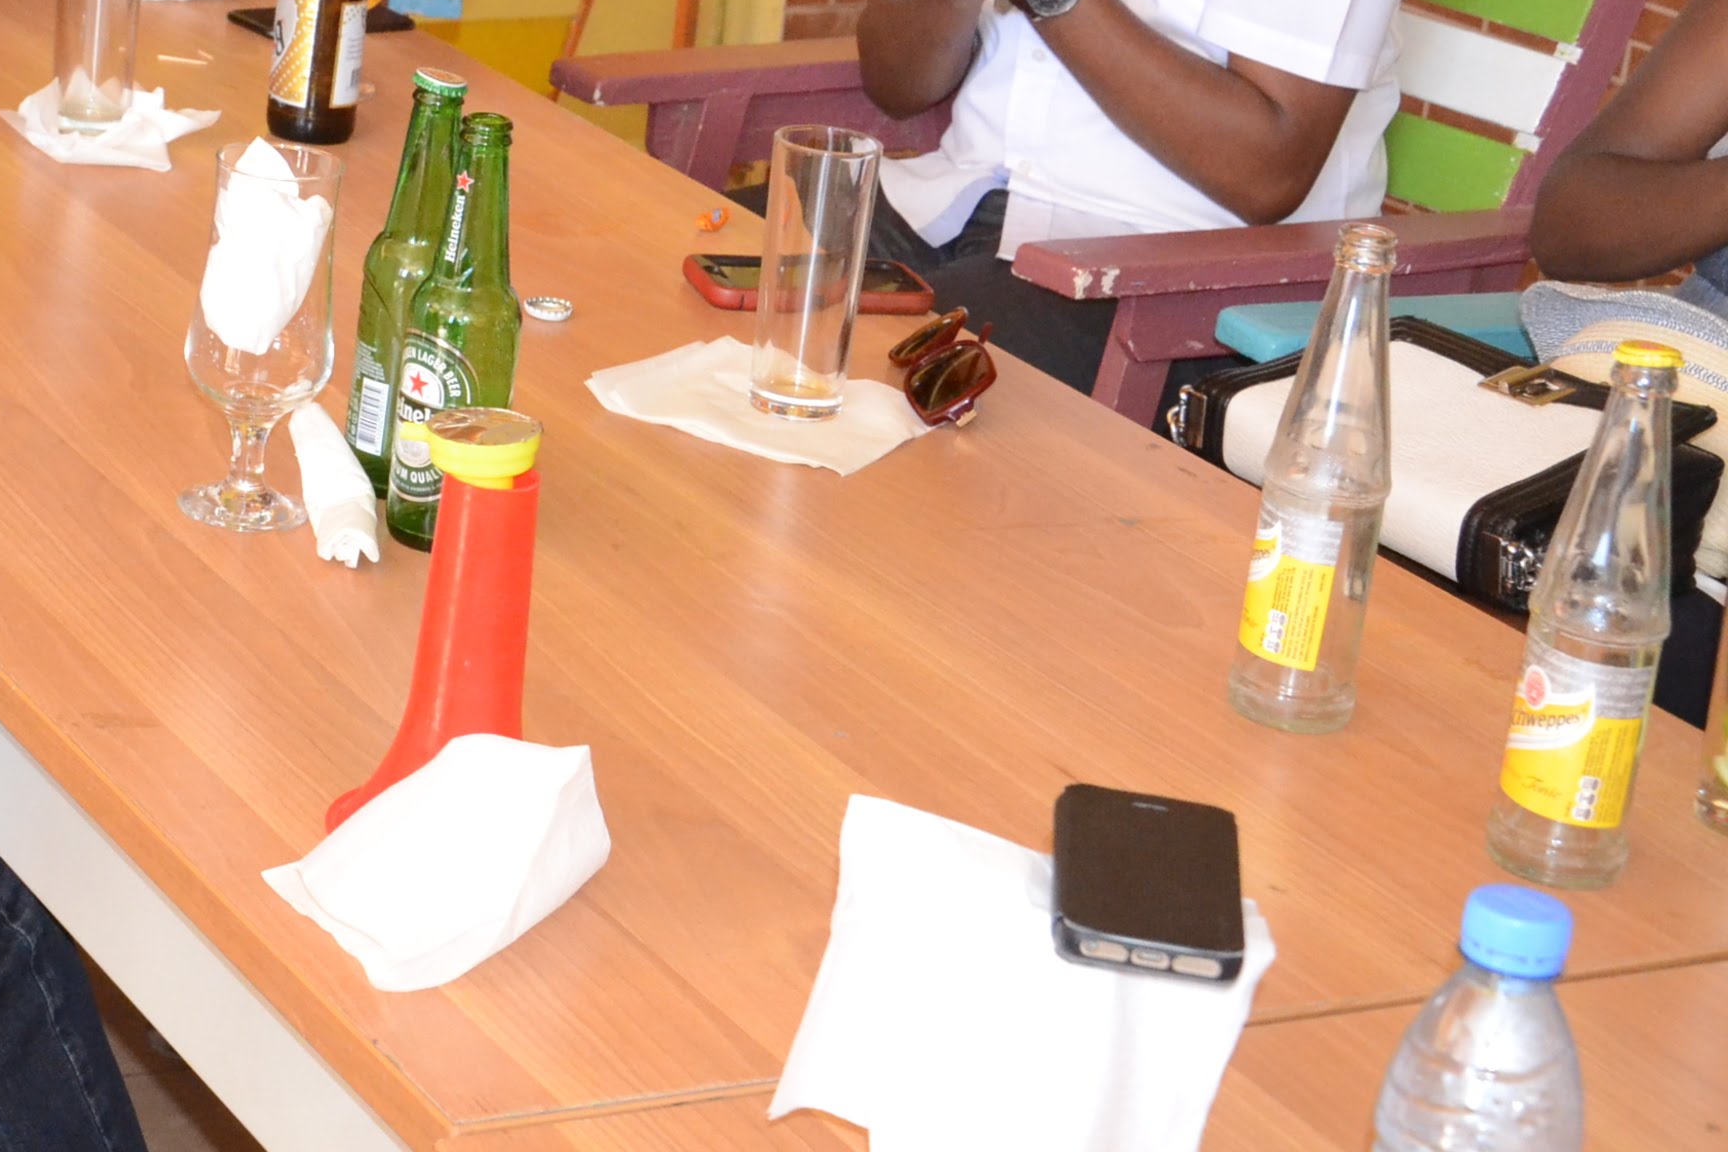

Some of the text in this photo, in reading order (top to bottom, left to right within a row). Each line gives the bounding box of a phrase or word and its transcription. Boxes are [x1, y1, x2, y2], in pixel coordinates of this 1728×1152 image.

[444, 195, 466, 263] Heineken
[417, 348, 447, 374] LAGER
[443, 370, 462, 397] BEER
